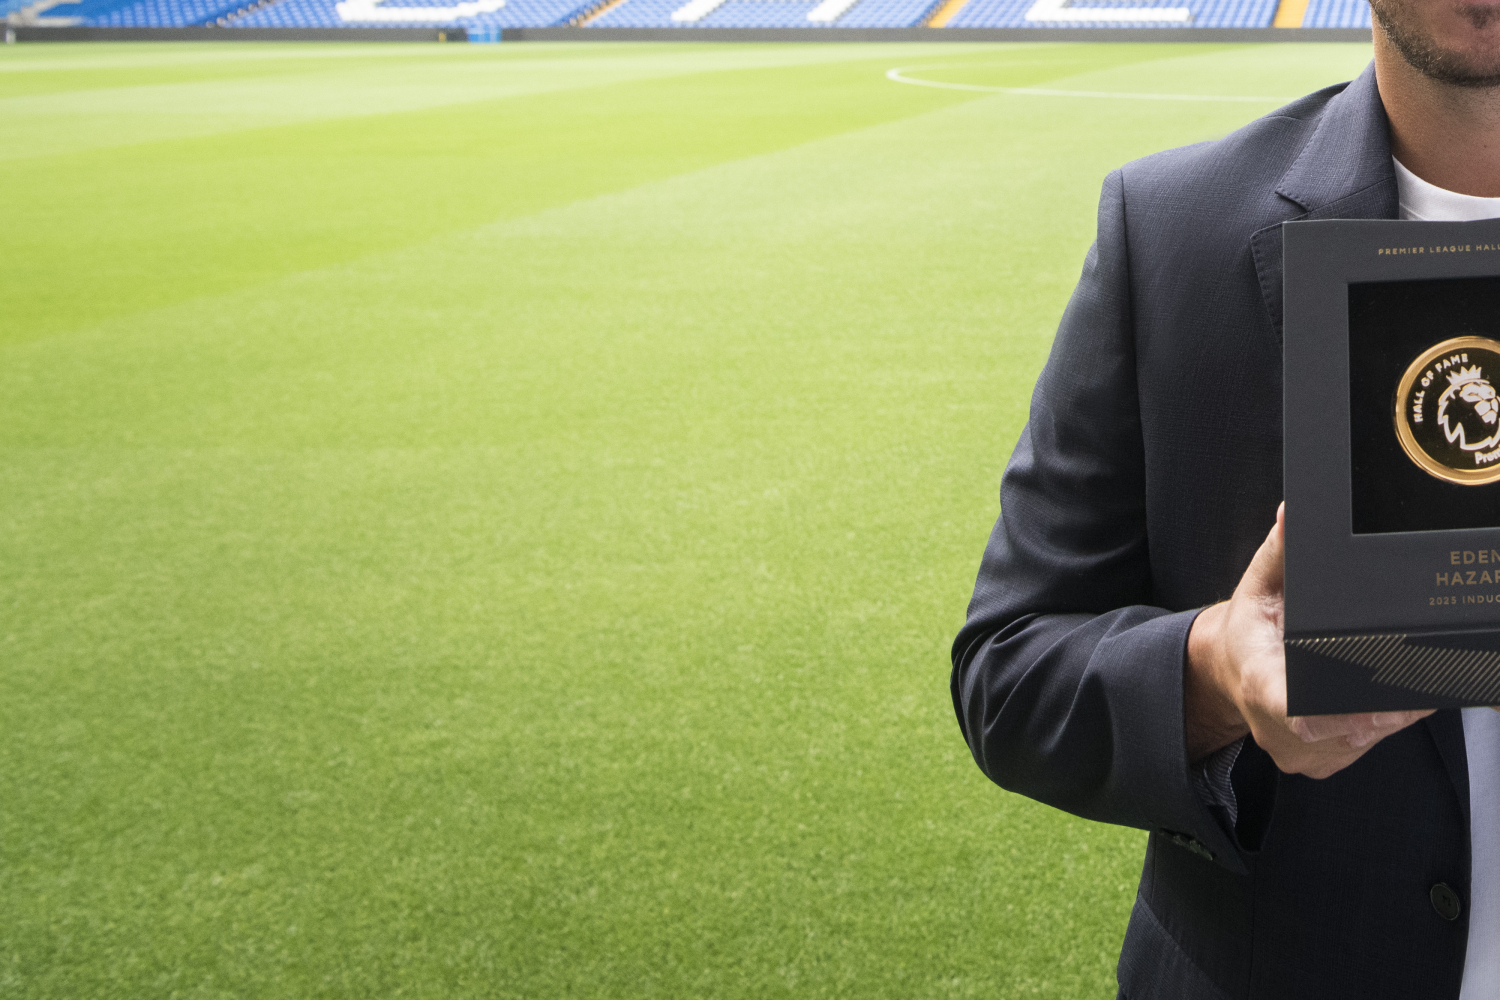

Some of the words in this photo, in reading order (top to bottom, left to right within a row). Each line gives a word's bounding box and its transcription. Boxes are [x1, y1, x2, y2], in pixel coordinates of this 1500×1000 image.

[1378, 247, 1425, 256] PREMIER
[1429, 244, 1471, 253] LEAGUE
[1413, 391, 1425, 423] HALL
[1421, 370, 1434, 387] OF
[1435, 353, 1468, 373] FAME
[1429, 596, 1457, 606] 2025
